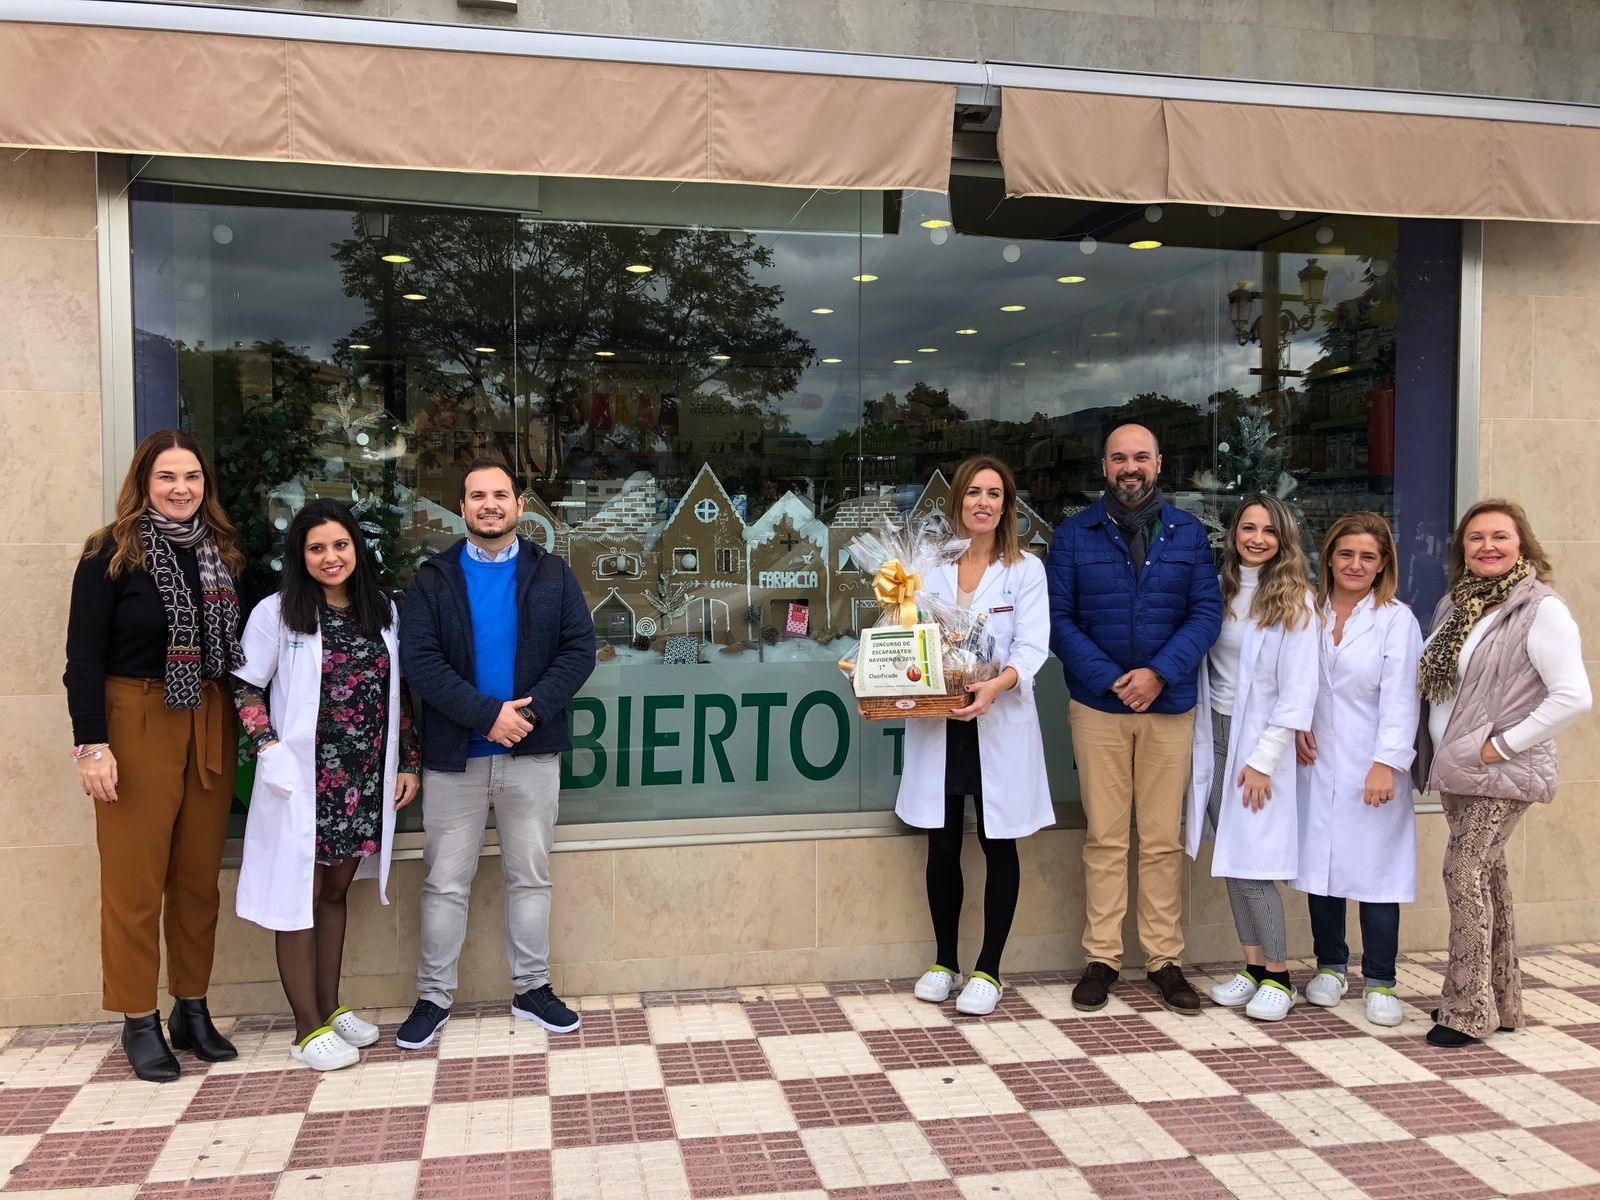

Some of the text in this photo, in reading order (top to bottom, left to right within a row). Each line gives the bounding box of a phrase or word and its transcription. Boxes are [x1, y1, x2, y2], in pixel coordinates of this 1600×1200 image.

[759, 571, 818, 588] FARMACIA
[868, 655, 902, 663] NAVIDEÑOS
[560, 689, 850, 790] BIERTO
